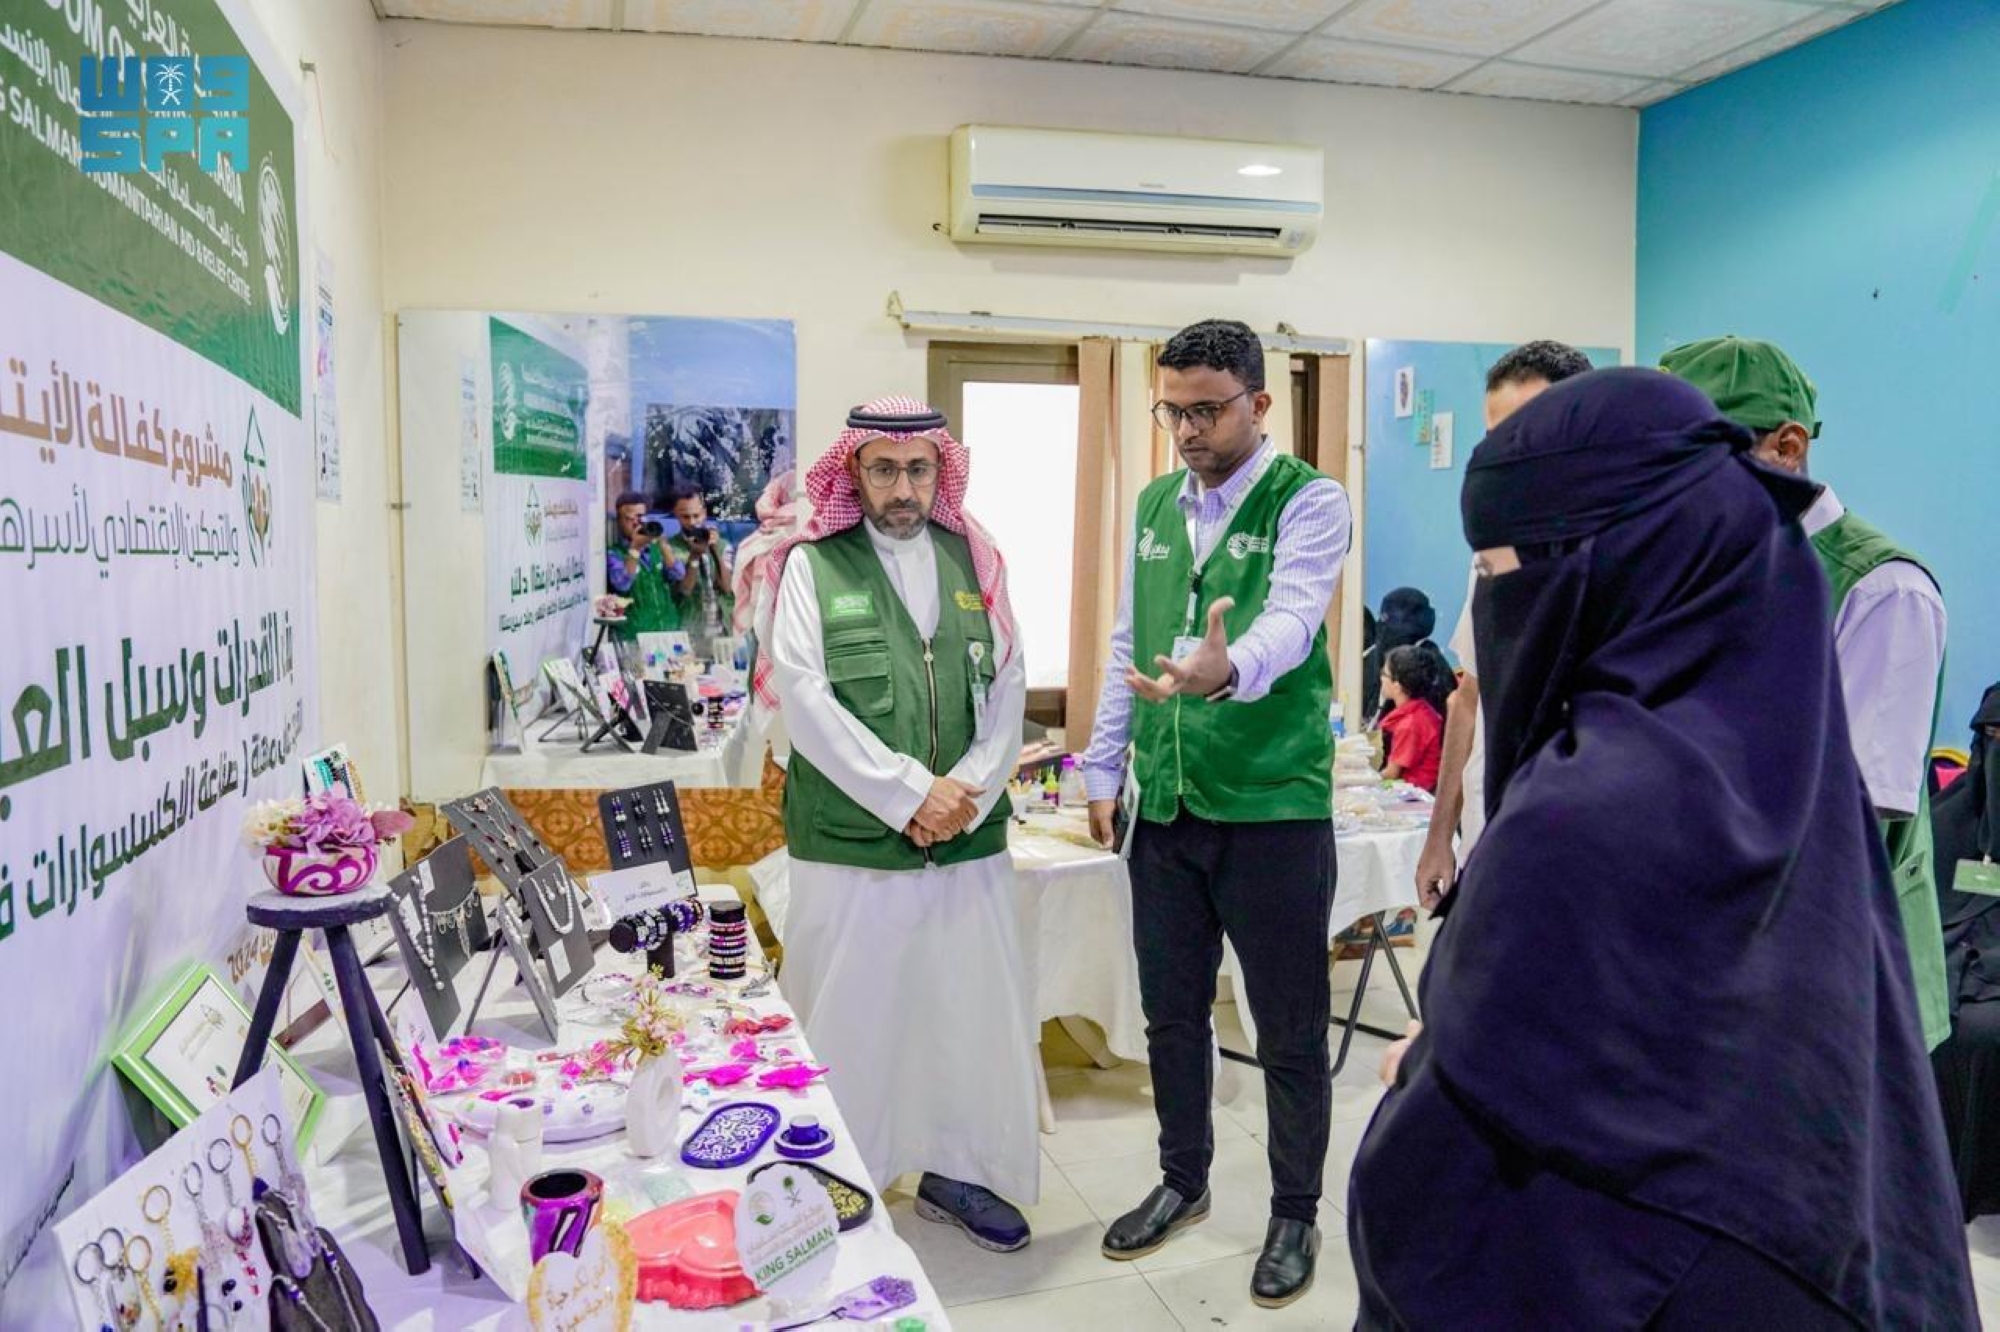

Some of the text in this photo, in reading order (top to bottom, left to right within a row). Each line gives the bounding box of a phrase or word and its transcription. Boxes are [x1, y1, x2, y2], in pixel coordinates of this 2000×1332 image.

[10, 85, 83, 167] SALMAN
[87, 381, 168, 467] كفالة
[171, 421, 233, 488] مشروع
[105, 637, 207, 762] وسبل
[213, 611, 281, 718] القدرات
[755, 1256, 785, 1284] KING
[785, 1225, 834, 1264] SALMAN
